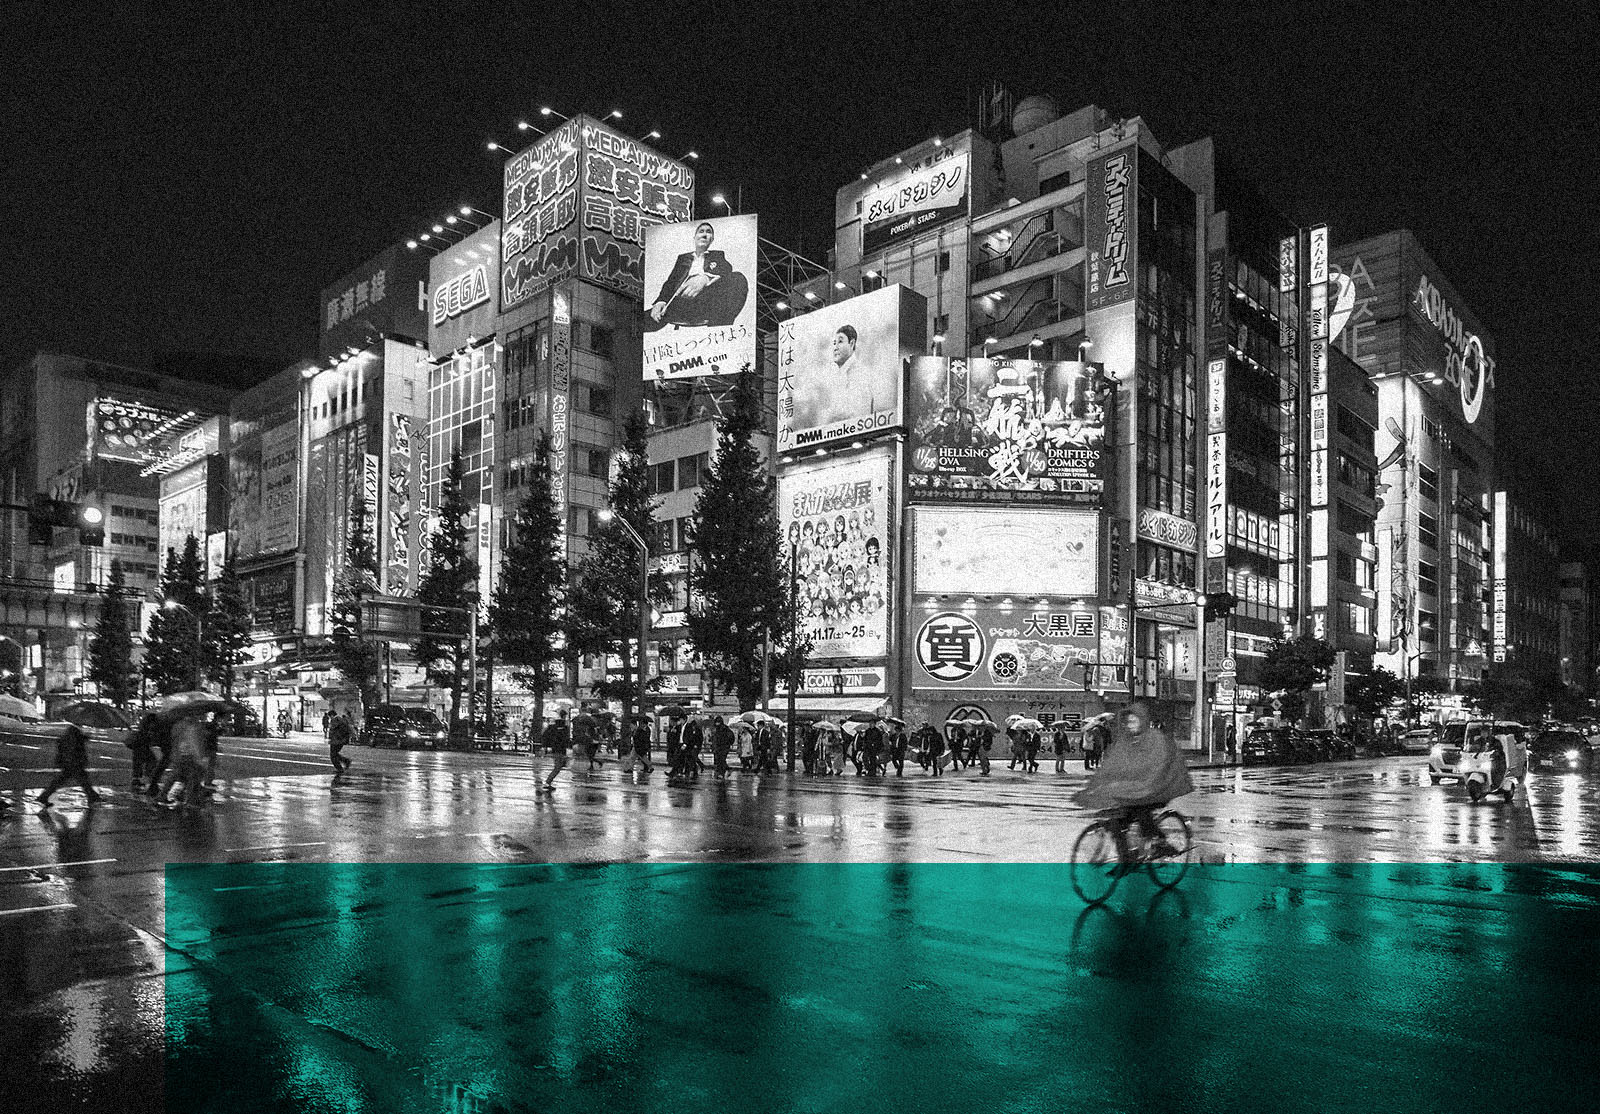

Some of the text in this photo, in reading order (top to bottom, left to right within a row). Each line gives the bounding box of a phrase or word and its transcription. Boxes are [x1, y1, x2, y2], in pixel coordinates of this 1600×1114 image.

[868, 166, 961, 222] メイドカジノ
[890, 211, 937, 235] POKER STARS
[434, 265, 488, 325] SEGA
[1313, 307, 1323, 335] Yellow
[669, 353, 728, 373] DMM.com
[779, 322, 795, 449] 次は太陽か。
[857, 411, 894, 430] solar
[939, 448, 989, 458] HELLSING
[939, 457, 960, 466] OVA
[1048, 449, 1100, 459] DRIFTERS
[1048, 459, 1095, 468] COMICS 6
[1024, 613, 1095, 637] 大黒屋
[925, 624, 979, 673] 質
[808, 675, 862, 687] COM ZIN
[1020, 712, 1082, 732] 黒屋
